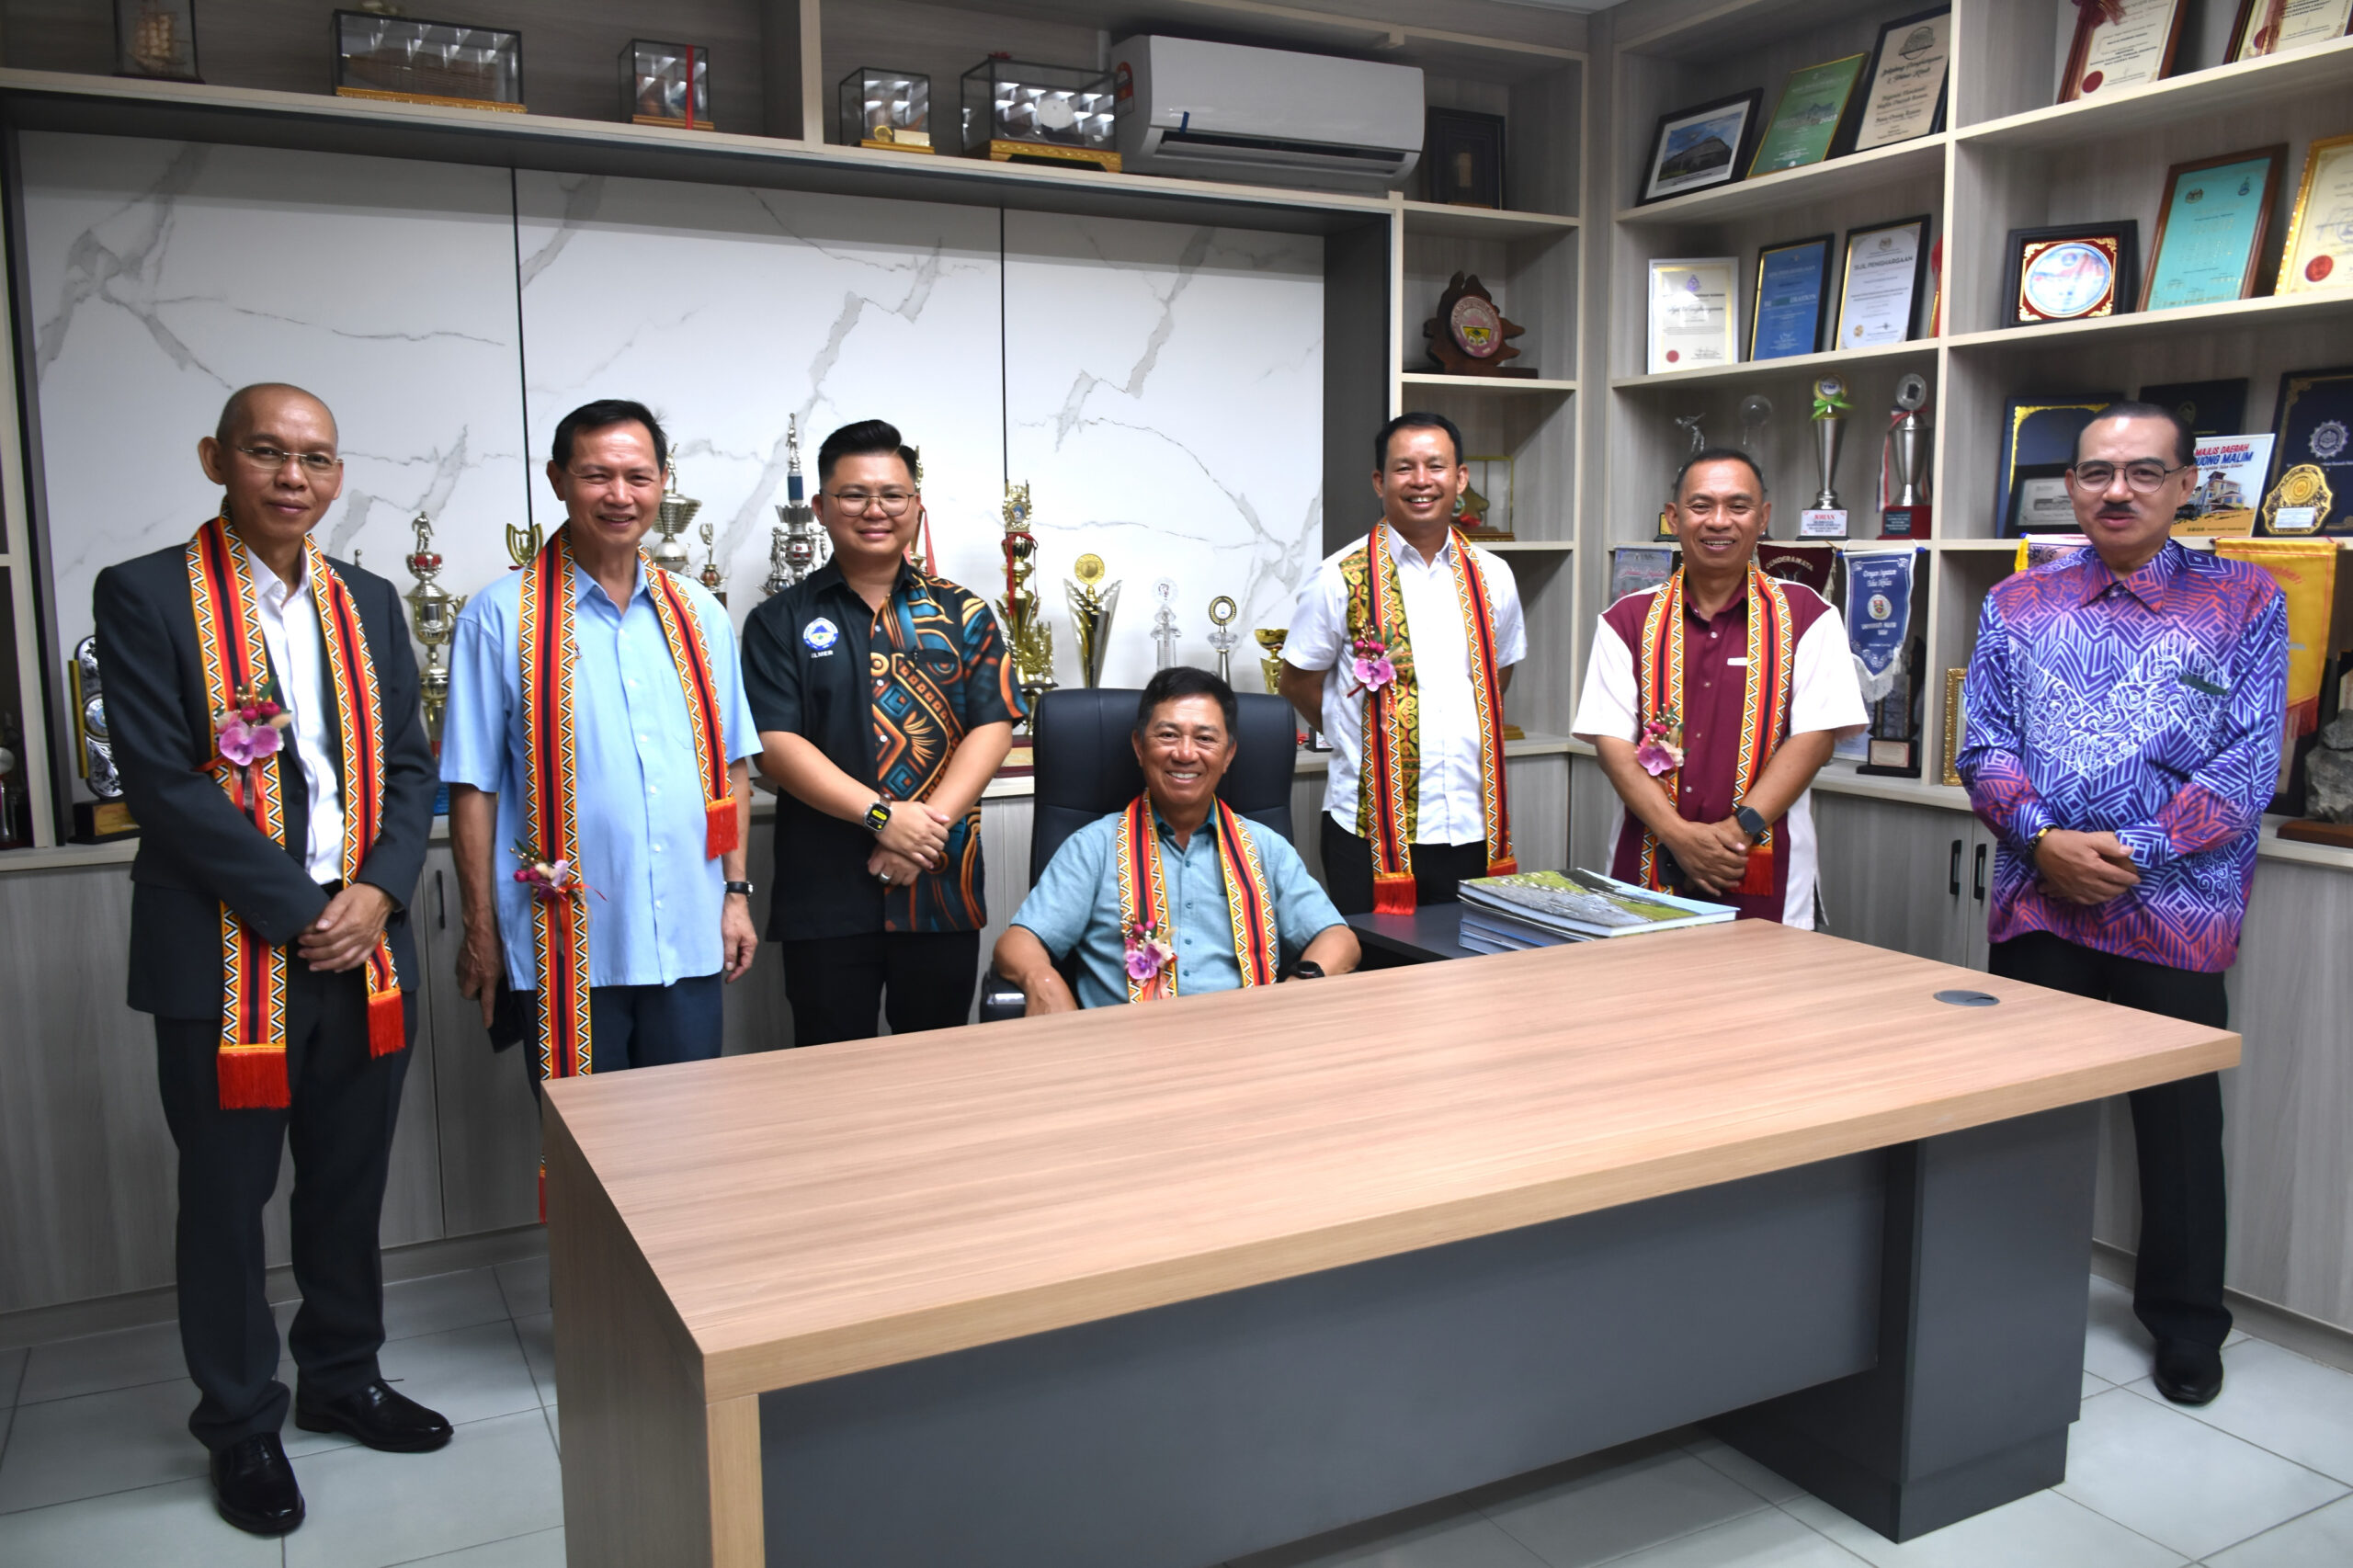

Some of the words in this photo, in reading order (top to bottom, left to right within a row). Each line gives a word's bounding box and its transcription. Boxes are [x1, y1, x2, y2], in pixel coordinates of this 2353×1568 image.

[2195, 447, 2220, 456] MAJLIS
[2221, 444, 2250, 454] DAERAH
[2221, 451, 2255, 464] MALIM
